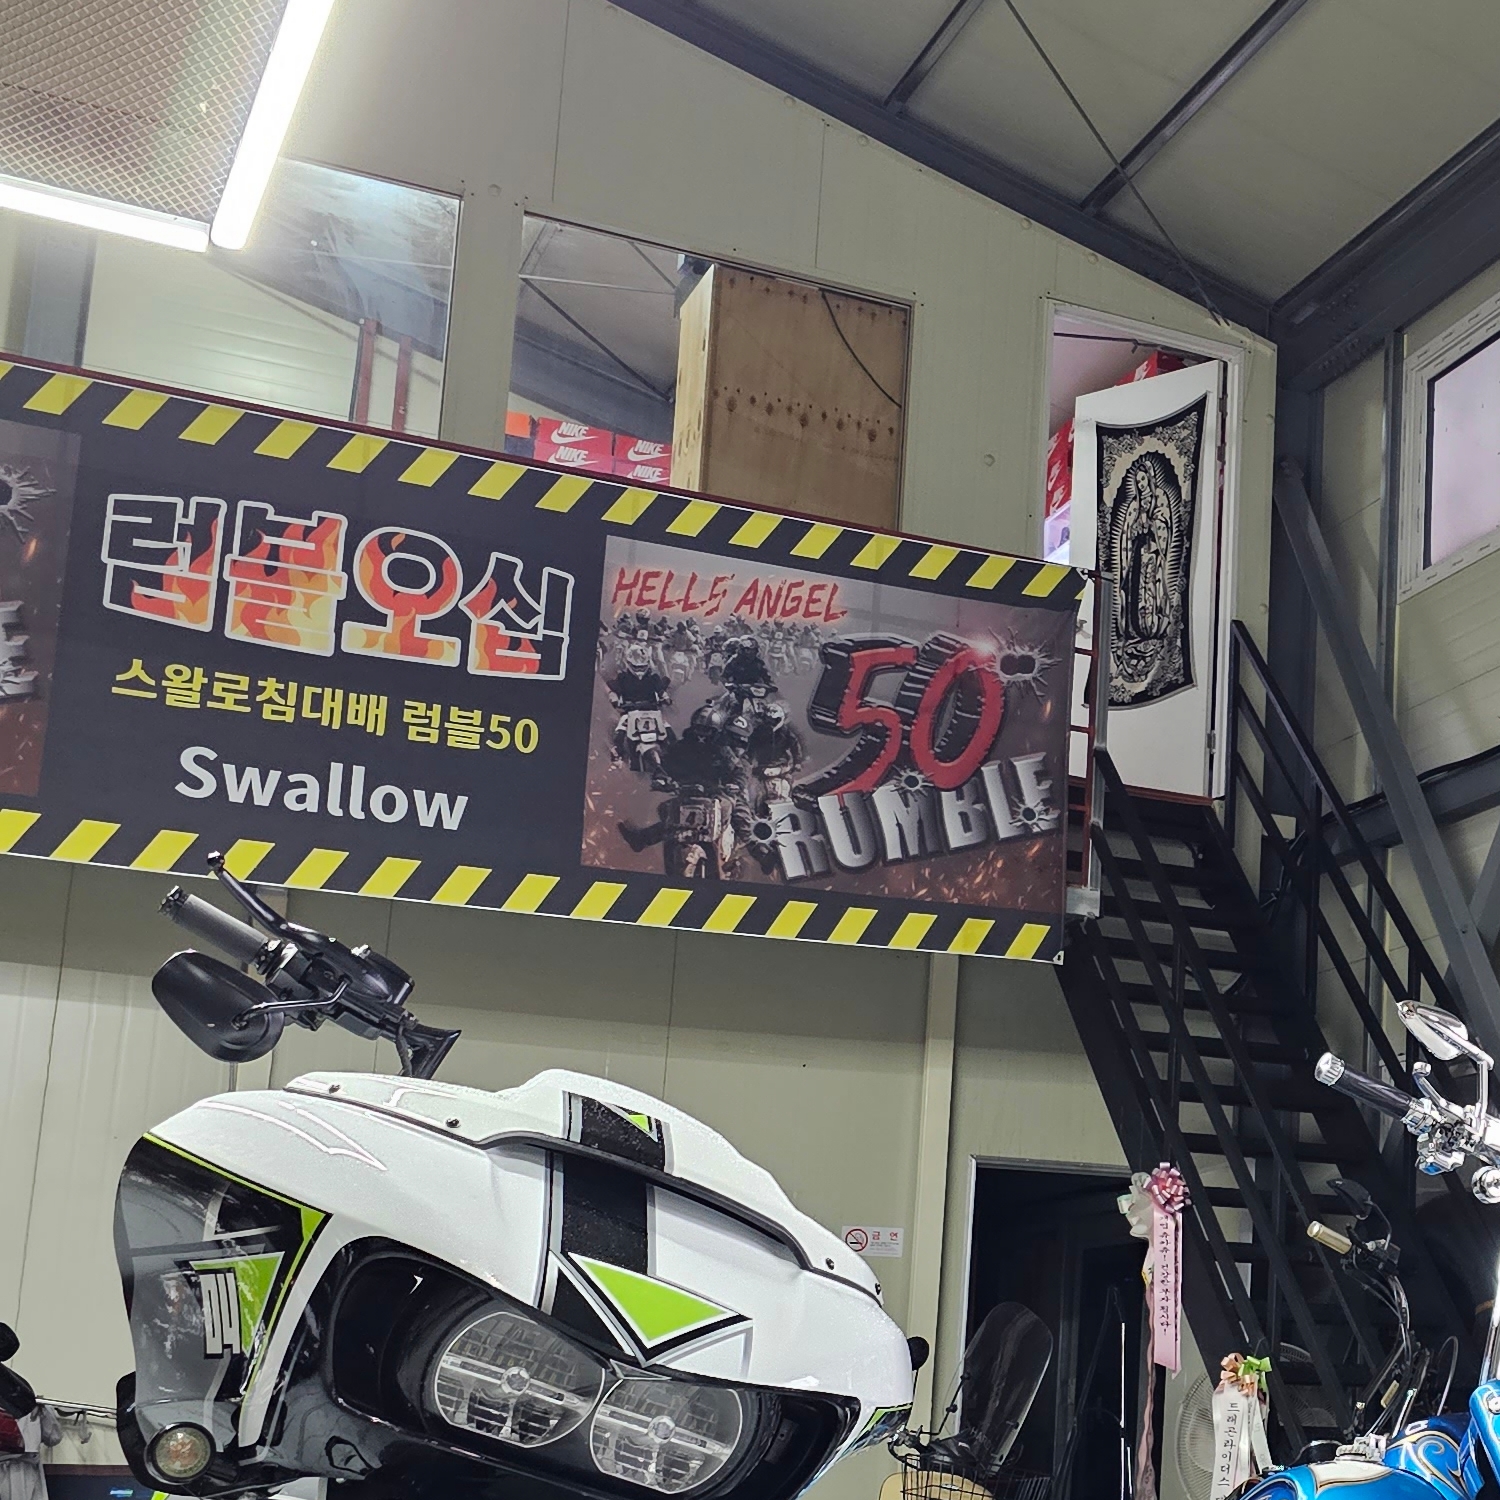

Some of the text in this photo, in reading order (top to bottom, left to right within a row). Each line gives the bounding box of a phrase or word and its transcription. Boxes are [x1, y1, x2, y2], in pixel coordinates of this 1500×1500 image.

[556, 445, 589, 463] NIKE
[557, 421, 589, 437] NIKE
[634, 439, 665, 455] NIKE
[633, 464, 664, 480] NIKE
[101, 493, 575, 680] 럼블오십
[733, 577, 848, 623] ANGEL
[111, 658, 540, 754] 스왈로침대배 럼블50
[806, 630, 1006, 797] 50
[175, 745, 469, 831] Swallow
[768, 752, 1060, 880] RUMBLE
